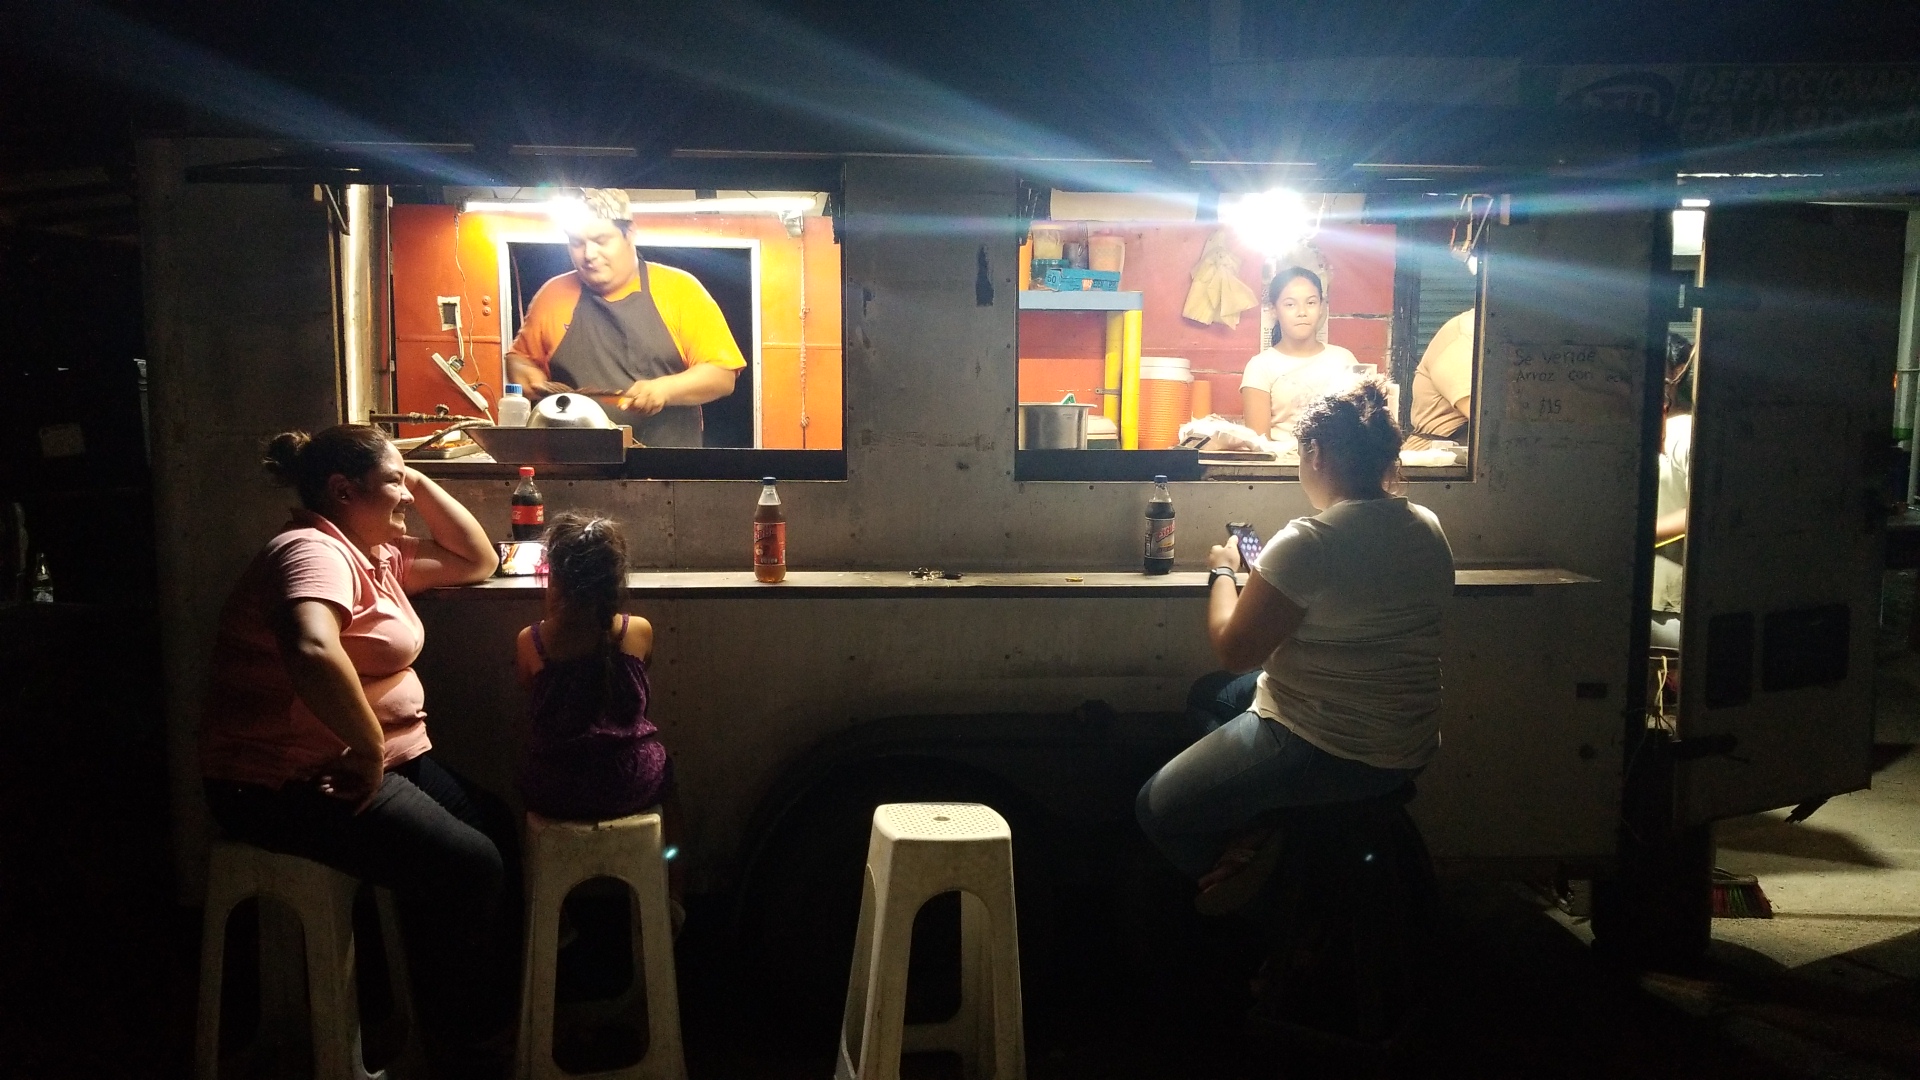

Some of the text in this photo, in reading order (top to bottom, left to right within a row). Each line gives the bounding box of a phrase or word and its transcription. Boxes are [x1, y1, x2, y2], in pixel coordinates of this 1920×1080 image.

[1047, 274, 1057, 284] 50
[1515, 349, 1532, 366] Se
[1516, 370, 1555, 383] Arroz
[1568, 370, 1593, 382] con
